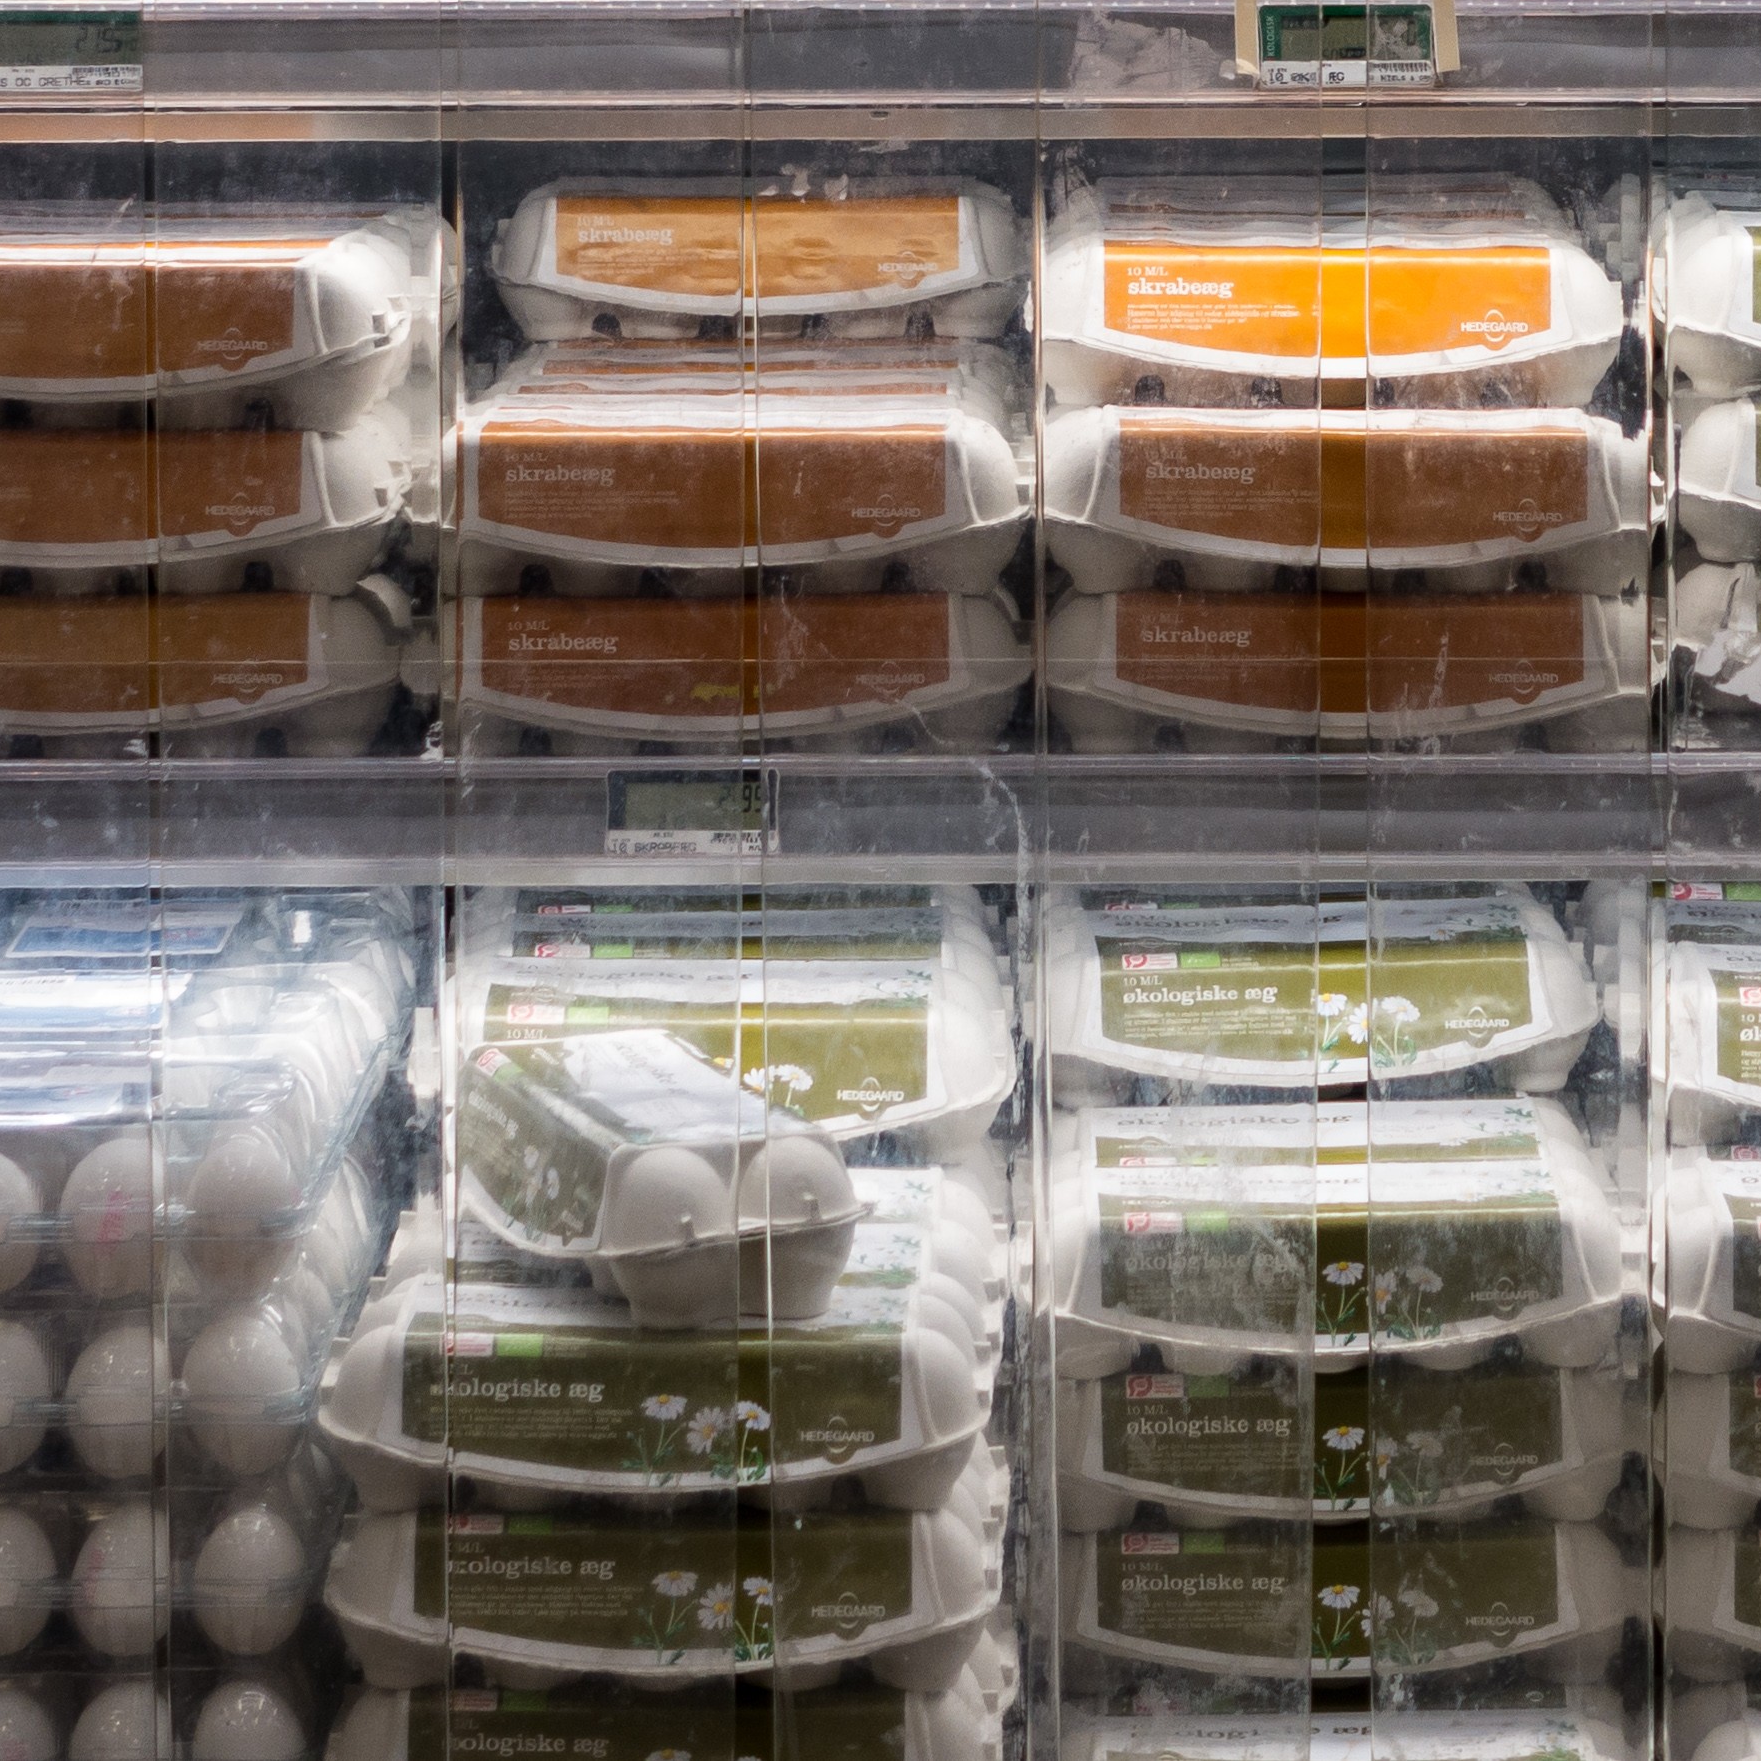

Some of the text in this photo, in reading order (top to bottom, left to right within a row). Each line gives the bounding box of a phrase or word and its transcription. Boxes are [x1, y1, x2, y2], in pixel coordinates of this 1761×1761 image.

[577, 225, 675, 246] skrabeæg
[1127, 266, 1168, 276] 10 M/L
[1127, 277, 1234, 299] skrabeæg
[1461, 321, 1529, 333] HEDEGAARD
[505, 464, 615, 487] skrabeæg
[1146, 462, 1256, 485] skrabeæg
[851, 506, 921, 518] HEDEGAARD
[1493, 511, 1563, 523] HEDEGAARD
[508, 632, 618, 653] skrabeæg
[1141, 625, 1251, 648] skrabeæg
[1143, 976, 1165, 987] M/L
[1122, 986, 1278, 1006] økologiske æg
[506, 1028, 548, 1040] 10 M/L
[837, 1089, 904, 1101] HEDEGAARD
[568, 1382, 605, 1403] æg
[1126, 1414, 1292, 1438] økologiske æg
[579, 1558, 615, 1580] æg
[1121, 1571, 1286, 1595] økologiske æg
